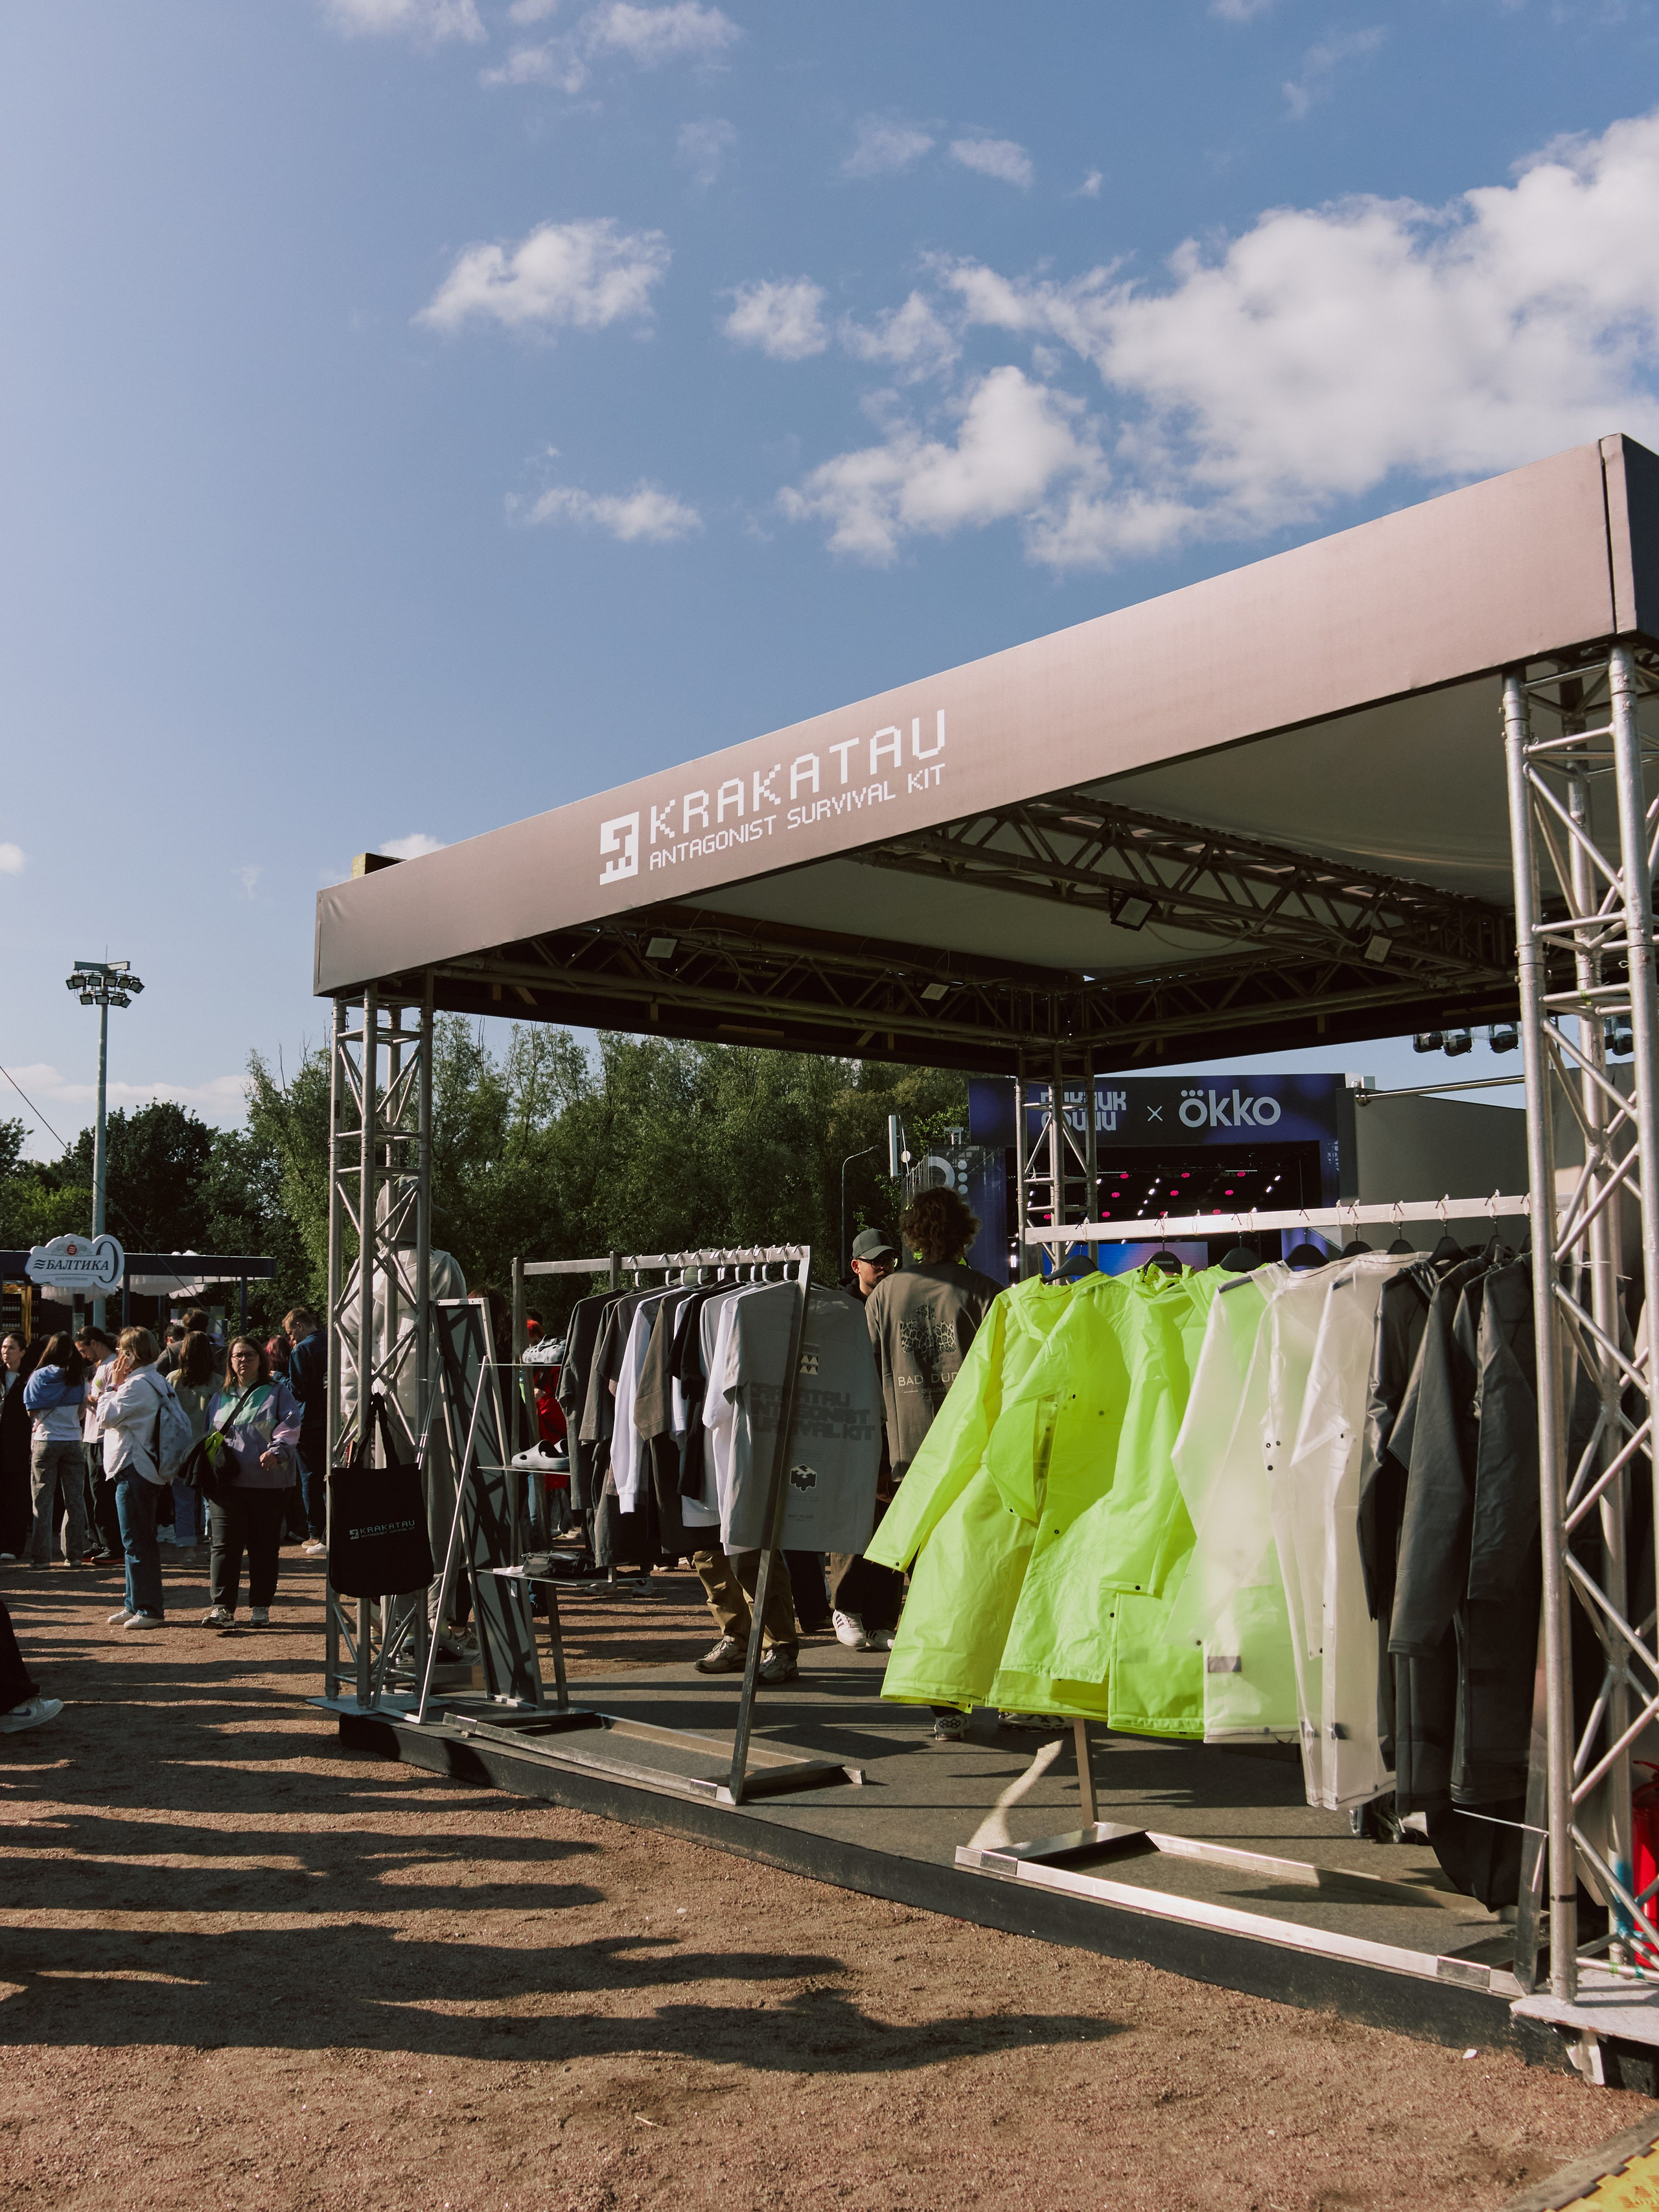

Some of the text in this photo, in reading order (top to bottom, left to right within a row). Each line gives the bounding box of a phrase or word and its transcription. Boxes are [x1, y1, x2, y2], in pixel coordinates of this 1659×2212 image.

[650, 709, 945, 844] KRAKATAU
[650, 763, 945, 870] ANTAGONIST SURVIVAL KIT
[46, 1259, 110, 1270] БАЛТИКА
[898, 1375, 923, 1386] BAD
[360, 1519, 415, 1534] KRAKATAU
